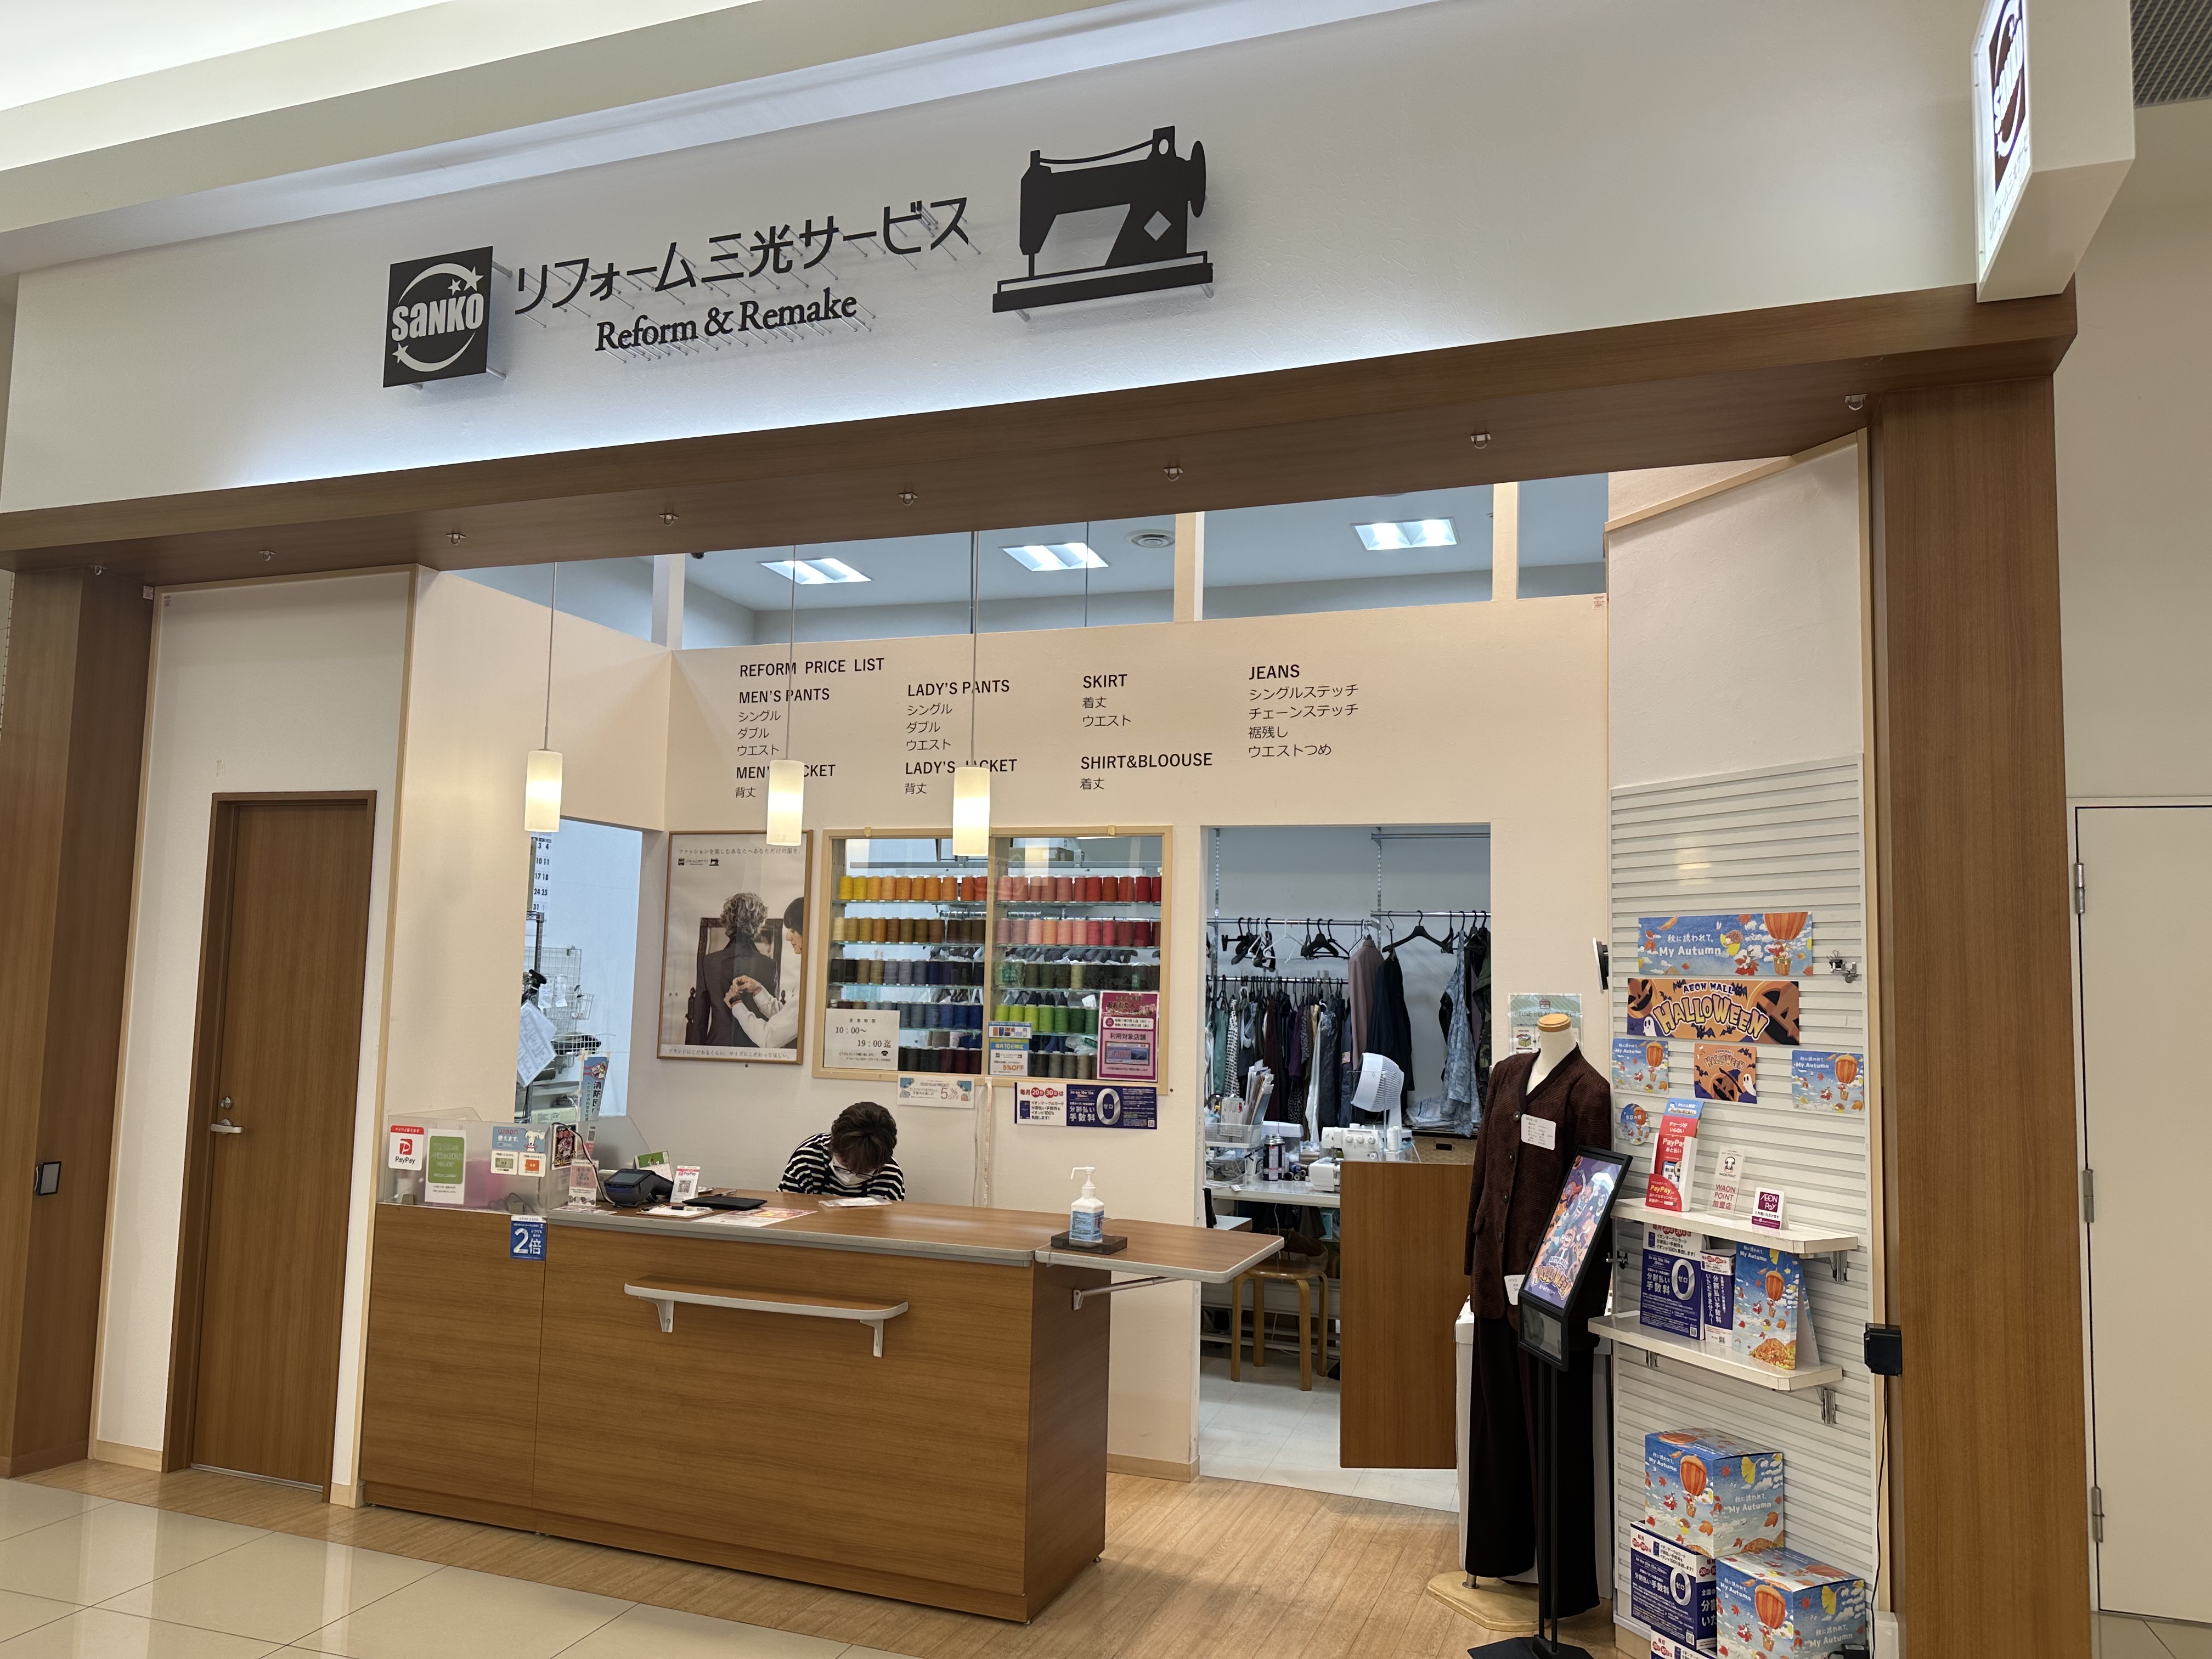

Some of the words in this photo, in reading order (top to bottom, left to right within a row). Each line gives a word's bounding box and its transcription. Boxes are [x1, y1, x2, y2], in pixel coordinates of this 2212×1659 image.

[515, 197, 969, 315] リフォーム三光サービス
[595, 314, 698, 352] Reform
[704, 307, 733, 336] &
[737, 287, 857, 332] Remake
[740, 662, 797, 678] REFORM
[805, 659, 847, 674] PRICE
[854, 657, 885, 672] LIST
[1249, 664, 1300, 680] JEANS
[908, 682, 958, 697] LADY'S
[962, 679, 1010, 694] PANTS
[1082, 674, 1128, 689] SKIRT
[739, 690, 781, 704] MEN'S
[786, 688, 830, 702] PANTS
[1249, 684, 1359, 702] シングルステッチ
[907, 702, 953, 716] シングル
[1082, 696, 1107, 709] 着丈
[738, 709, 781, 723] シングル
[1248, 703, 1359, 720] チェーンステッチ
[906, 721, 941, 734] ダブル
[1082, 714, 1132, 727] ウエスト
[737, 727, 770, 740] ダブル
[1248, 726, 1289, 740] 裾残し
[737, 743, 780, 756] ウエスト
[906, 738, 951, 752] ウエスト
[1248, 743, 1332, 758] ウエストつめ
[905, 761, 956, 775] LADY'S
[1080, 753, 1213, 770] SHIRT&BLOOUSE
[905, 783, 927, 794] 背丈
[1080, 777, 1105, 790] 着丈
[735, 787, 757, 798] 背丈
[544, 857, 549, 866] 11
[1667, 933, 1714, 943] 秋に誘われて。
[1659, 946, 1674, 957] My
[1678, 946, 1722, 955] Autumn
[1683, 983, 1707, 993] AEON
[1709, 982, 1734, 995] MALL
[1653, 994, 1768, 1039] HALLOWEEN
[1703, 1053, 1746, 1070] HALLOWEEN
[395, 1156, 415, 1165] PayPay
[1650, 1185, 1672, 1194] PayPay
[1716, 1183, 1736, 1193] WAON
[1714, 1192, 1734, 1201] POINT
[1765, 1202, 1777, 1210] Pay
[1678, 1274, 1688, 1283] ゼロ
[1649, 1457, 1657, 1465] My
[1657, 1459, 1677, 1472] Autumn
[1729, 1505, 1740, 1514] My
[1742, 1502, 1771, 1511] Autumn
[1675, 1581, 1685, 1591] ゼロ
[1720, 1582, 1728, 1591] My
[1729, 1585, 1751, 1601] Autumn
[1810, 1639, 1820, 1647] My
[1823, 1633, 1853, 1645] Autumn
